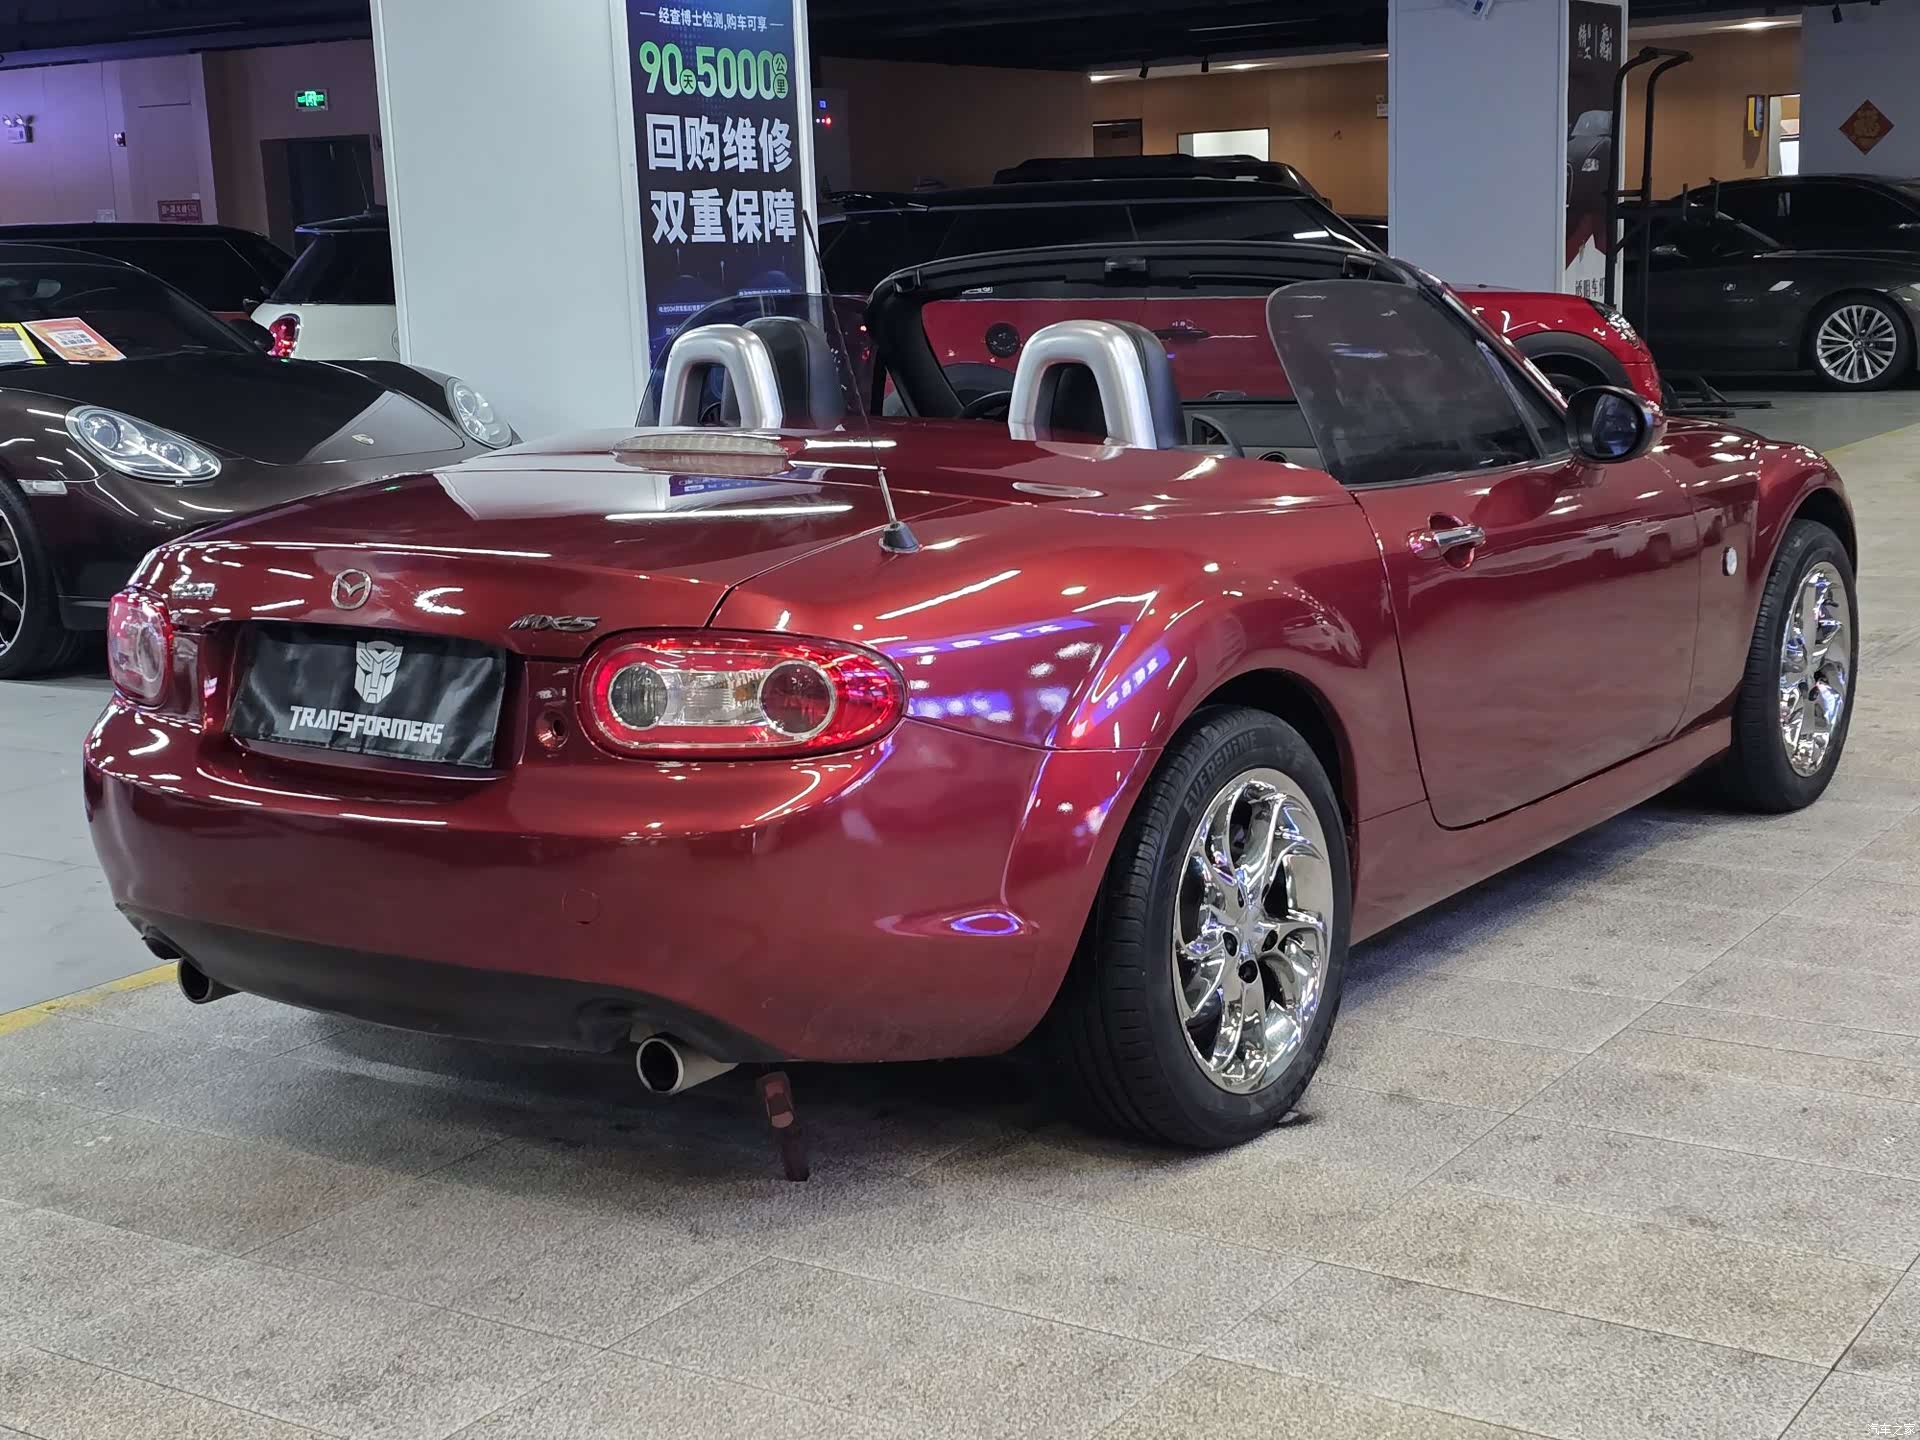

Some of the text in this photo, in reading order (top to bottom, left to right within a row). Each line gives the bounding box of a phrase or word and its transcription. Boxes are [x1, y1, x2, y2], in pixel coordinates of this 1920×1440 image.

[658, 6, 768, 32] 经查博士检测,购车可享
[646, 113, 793, 173] 回购维修
[650, 187, 797, 244] 双重保障
[289, 705, 445, 745] TRANSFORMERS
